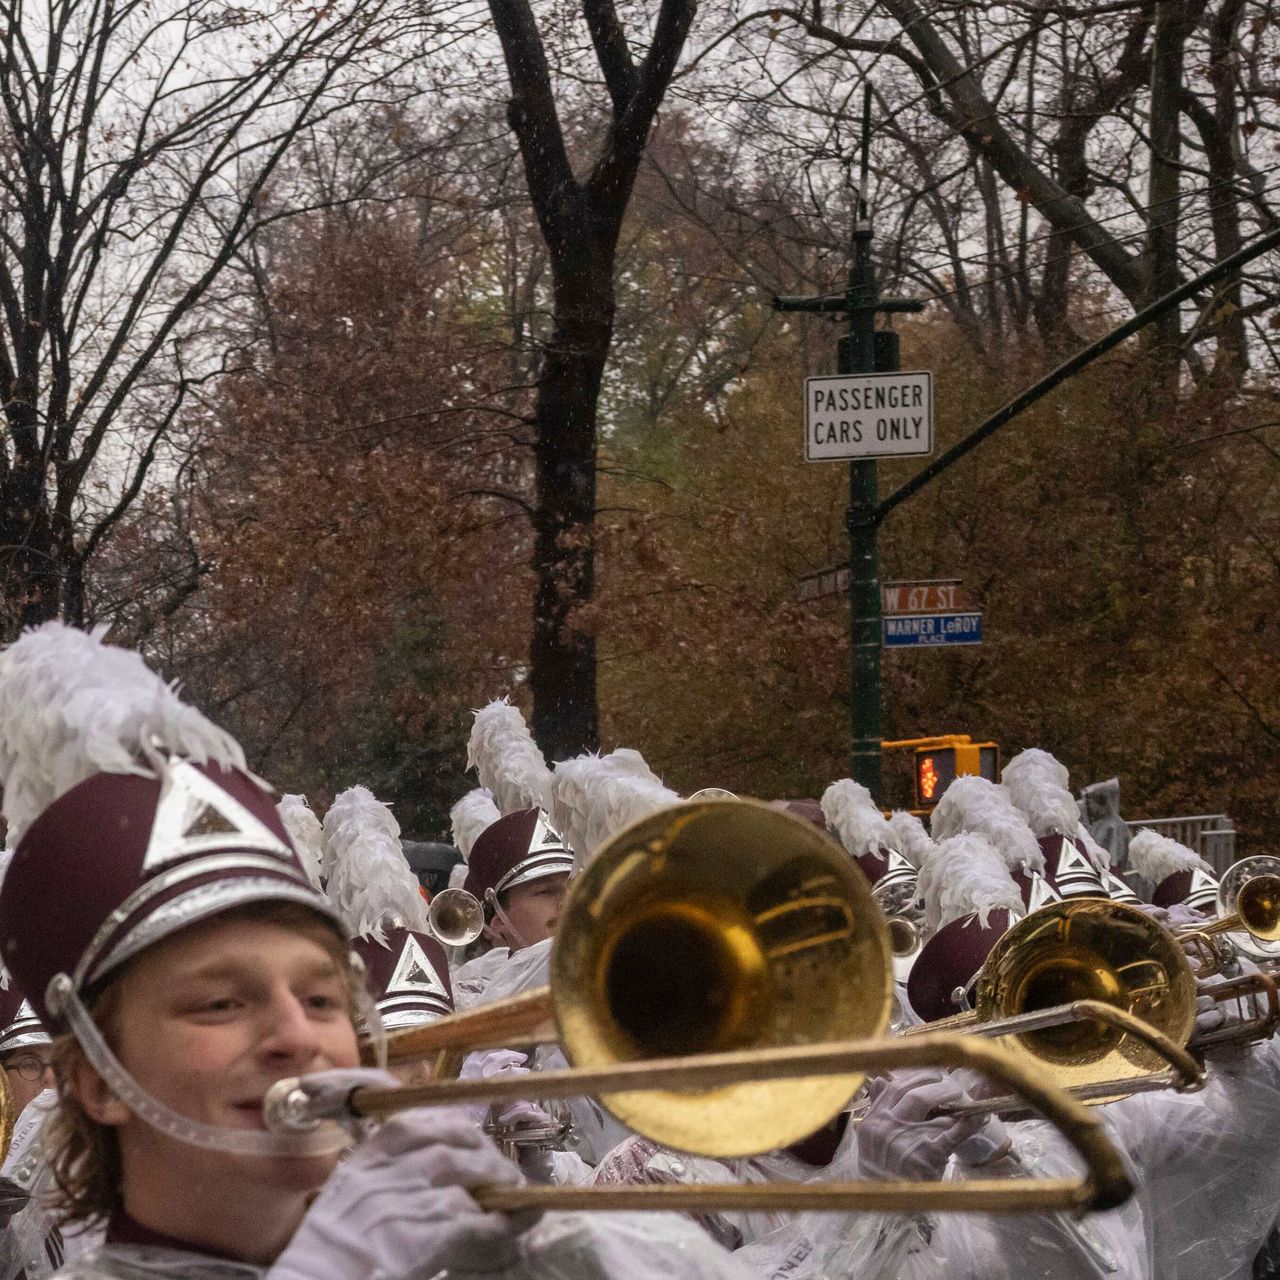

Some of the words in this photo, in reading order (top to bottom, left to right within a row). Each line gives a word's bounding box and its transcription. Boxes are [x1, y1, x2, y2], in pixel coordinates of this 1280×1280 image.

[814, 384, 922, 412] PASSENGER
[814, 420, 863, 444] CARS
[876, 416, 923, 441] ONLY
[886, 587, 900, 610] W
[908, 586, 928, 610] 67
[937, 585, 957, 609] ST
[887, 619, 934, 636] WARNER
[940, 617, 978, 633] LeROY
[918, 633, 946, 644] PLACE
